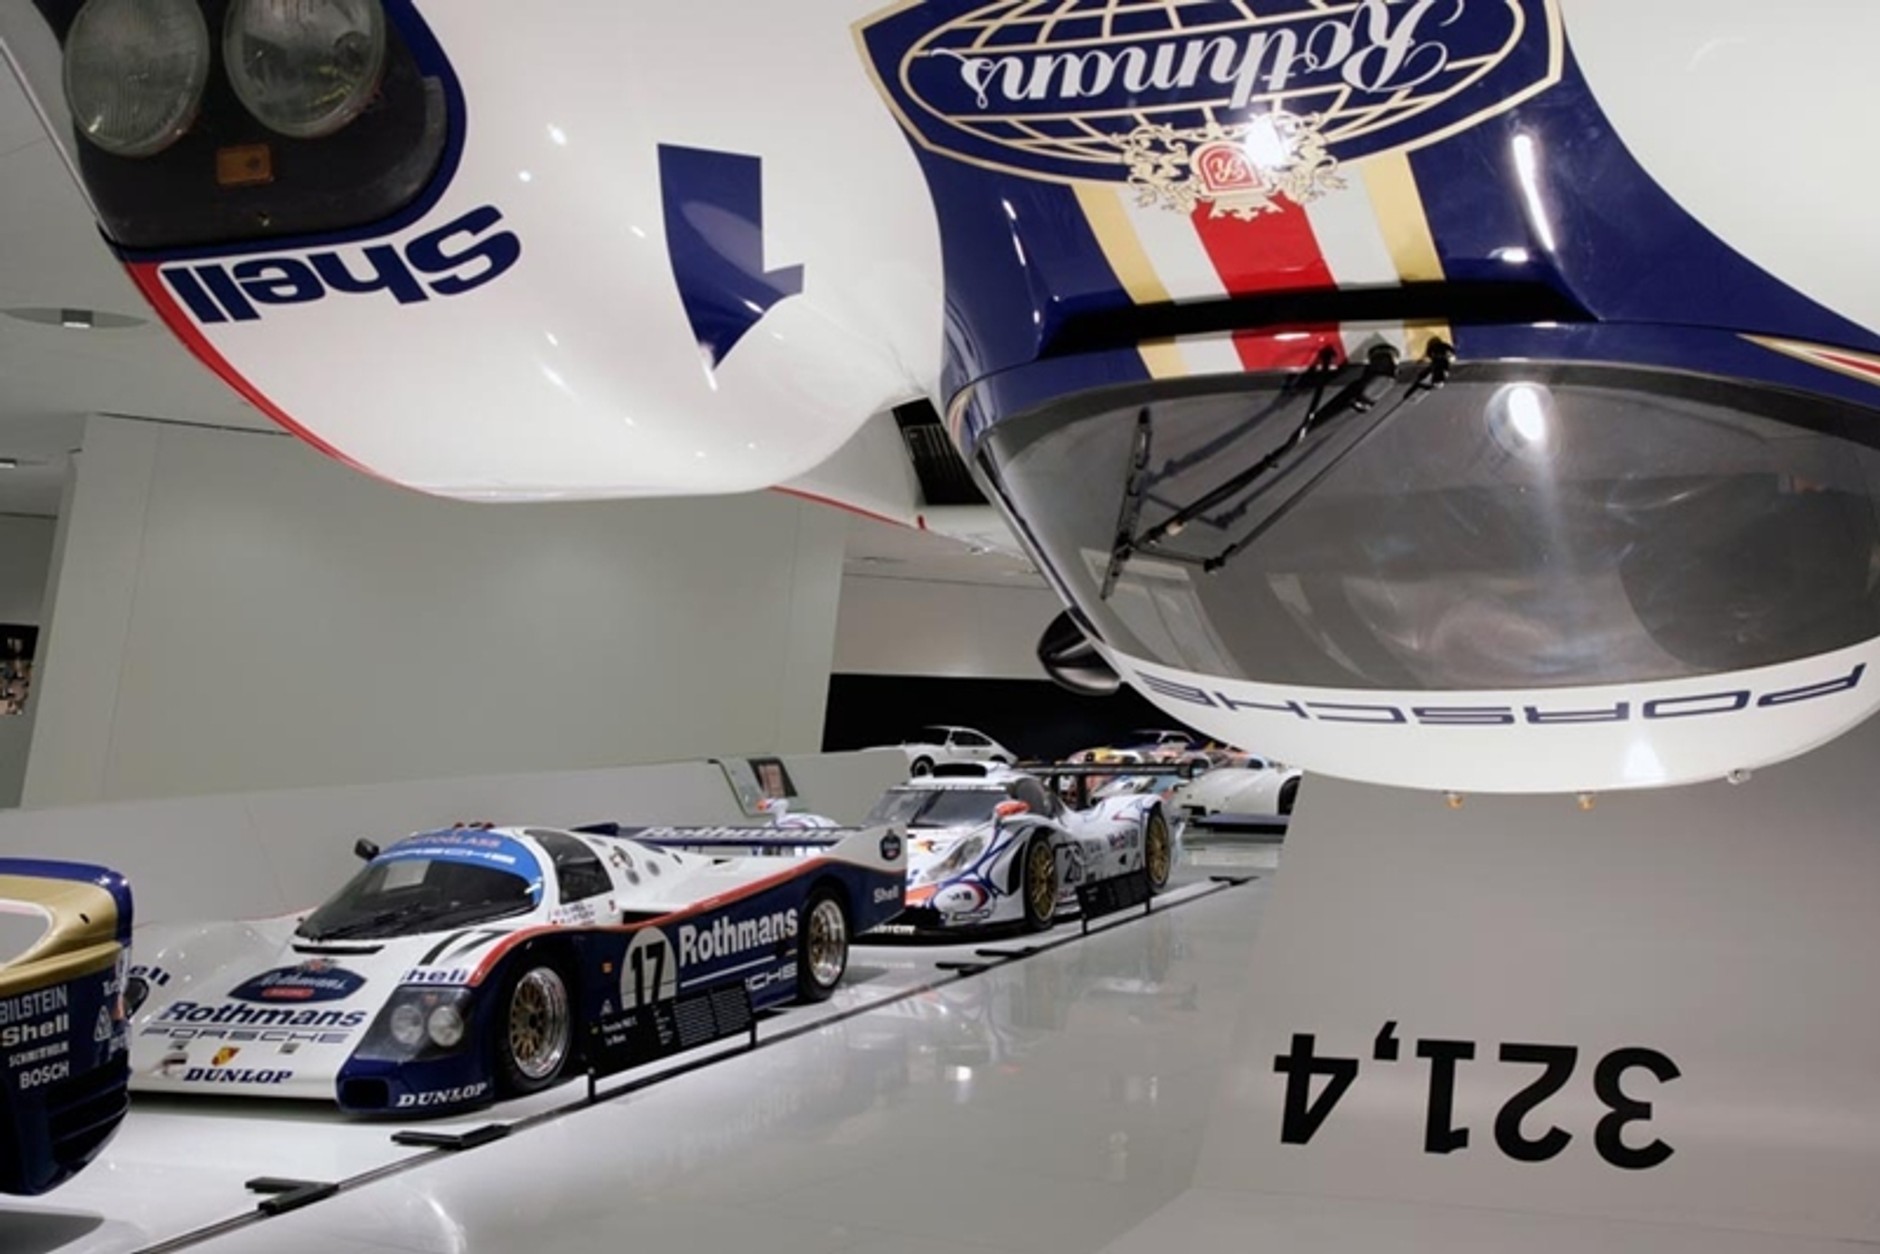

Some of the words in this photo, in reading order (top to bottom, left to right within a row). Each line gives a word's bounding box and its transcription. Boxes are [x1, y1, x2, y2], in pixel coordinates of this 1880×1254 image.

[930, 0, 1465, 108] Rothmans
[160, 204, 521, 324] Shell
[1136, 663, 1867, 725] PORSCHE
[873, 886, 900, 903] Shell
[678, 908, 798, 967] Rothmans
[630, 939, 666, 1004] 17
[0, 984, 68, 1025] BILSTEIN
[158, 1001, 368, 1028] Rothmans
[2, 1013, 70, 1048] Shell
[140, 1026, 350, 1044] PORSCHE
[19, 1060, 70, 1090] BOSCH
[184, 1067, 294, 1084] DUNLOP
[395, 1081, 488, 1108] DUNLOP
[1273, 1021, 1682, 1170] 321,4
